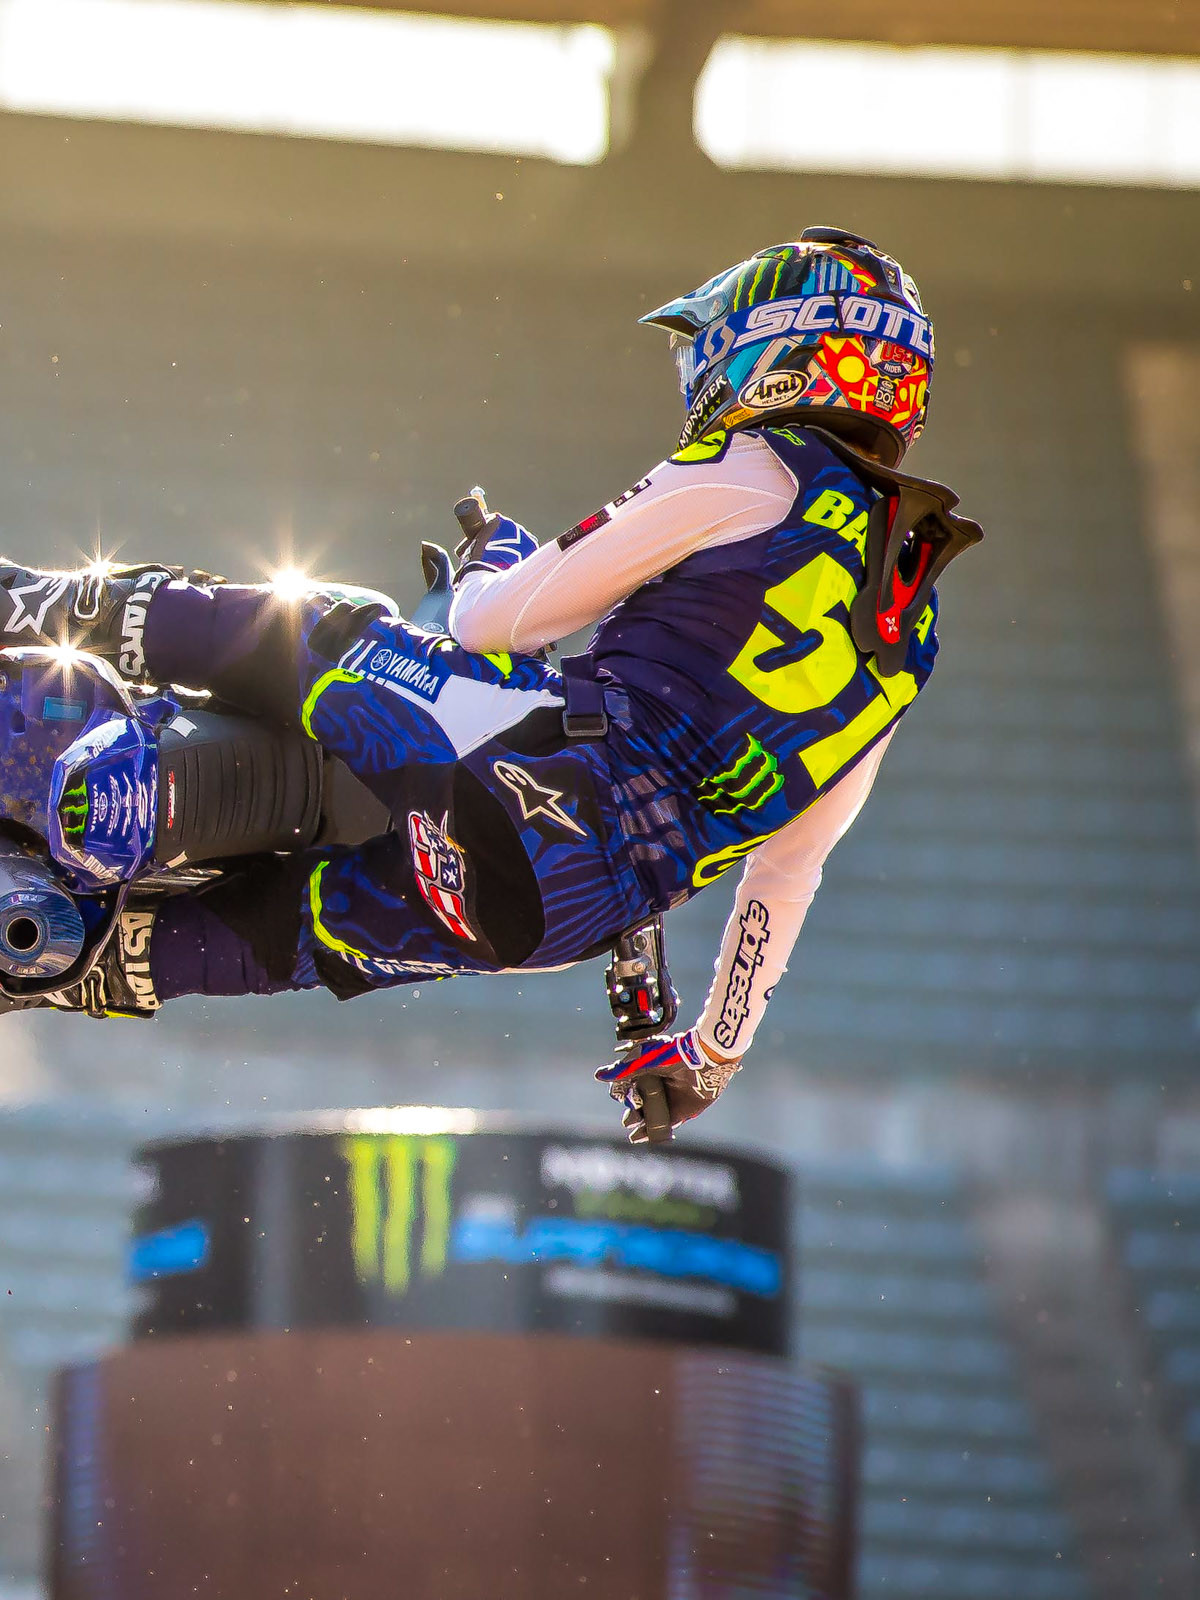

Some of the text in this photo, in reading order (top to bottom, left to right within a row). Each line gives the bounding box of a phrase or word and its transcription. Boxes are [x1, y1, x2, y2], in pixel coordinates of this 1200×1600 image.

[732, 295, 929, 355] SCOTT
[745, 372, 799, 404] Arai
[883, 362, 902, 374] RIDER
[679, 374, 728, 449] MONSTER
[875, 389, 896, 406] DOT
[726, 551, 919, 791] 51
[90, 783, 99, 833] YAMAHA
[713, 899, 770, 1049] alpinestars
